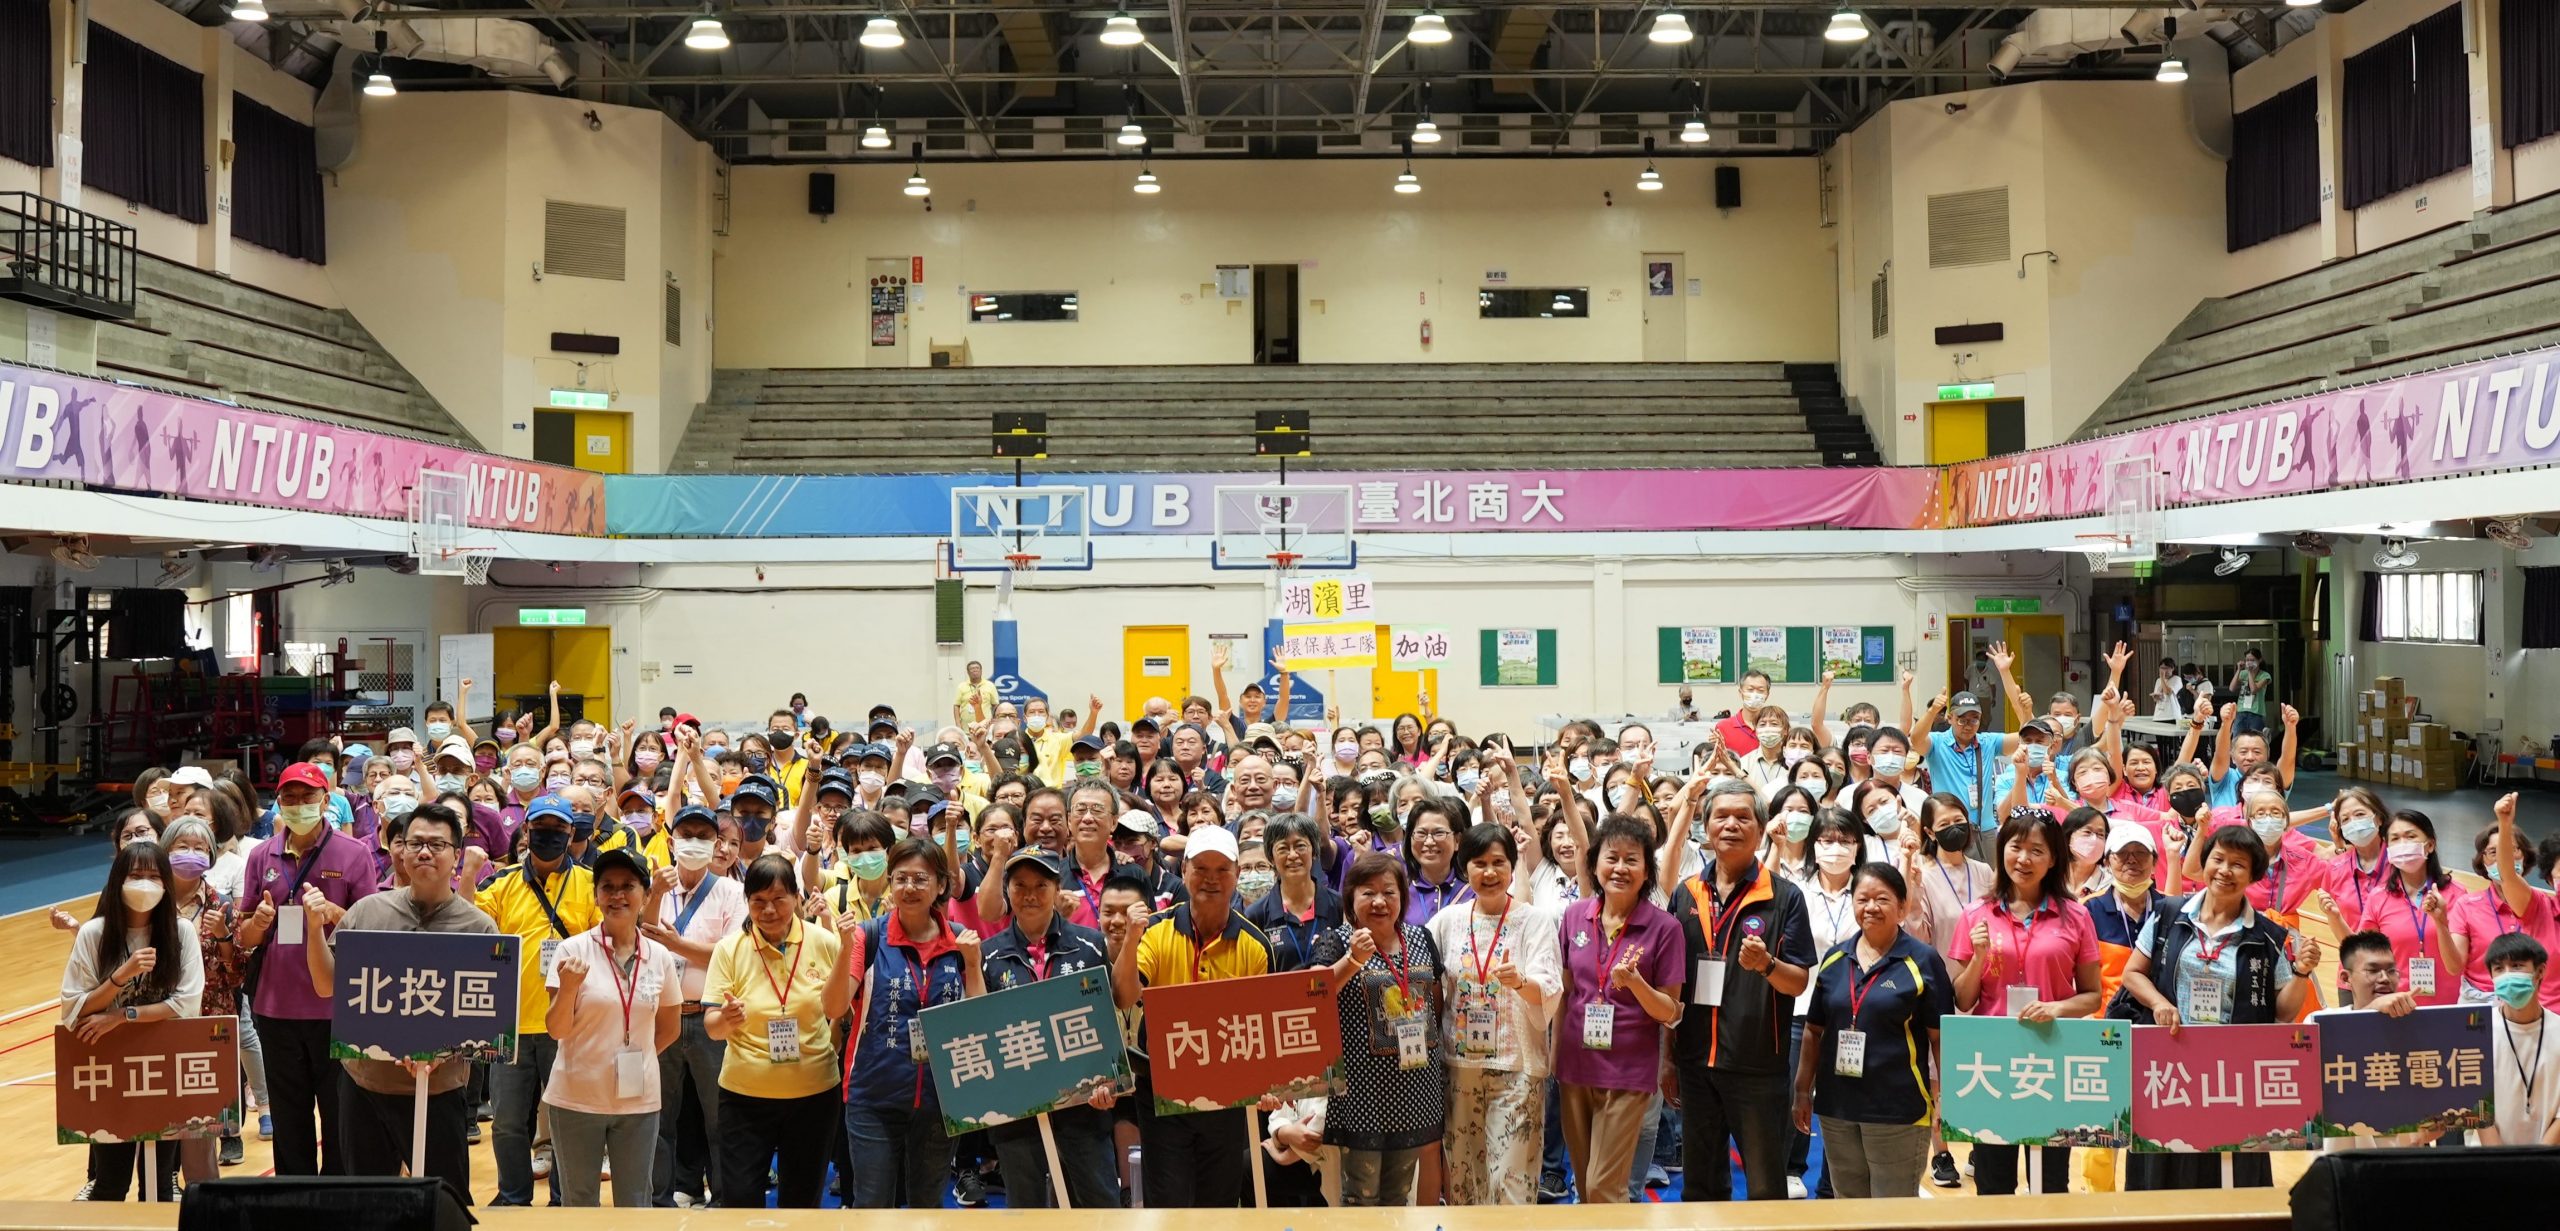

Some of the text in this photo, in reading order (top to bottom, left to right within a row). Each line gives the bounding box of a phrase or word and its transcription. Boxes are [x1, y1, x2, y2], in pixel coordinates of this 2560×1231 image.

[208, 418, 335, 500] NTUB
[2182, 411, 2298, 492] NTUB
[467, 463, 541, 523] NTUB
[975, 480, 1565, 528] NTUB 臺北商大
[1973, 462, 2042, 520] NTUB
[1284, 580, 1371, 616] 湖濱里
[1285, 633, 1376, 658] 環保義工隊
[1395, 634, 1448, 659] 加油
[348, 967, 499, 1018] 北投區
[903, 966, 912, 991] 中正區
[886, 977, 902, 1049] 環保義工中隊
[1165, 1006, 1321, 1070] 內湖區
[942, 1005, 1104, 1089] 萬華區
[2100, 1039, 2123, 1047] TAIPEI
[2290, 1042, 2313, 1050] TAIPEI
[73, 1051, 220, 1102] 中正區
[1956, 1052, 2111, 1103] 大安區
[2143, 1059, 2302, 1110] 松山區
[2324, 1048, 2486, 1095] 中華電信
